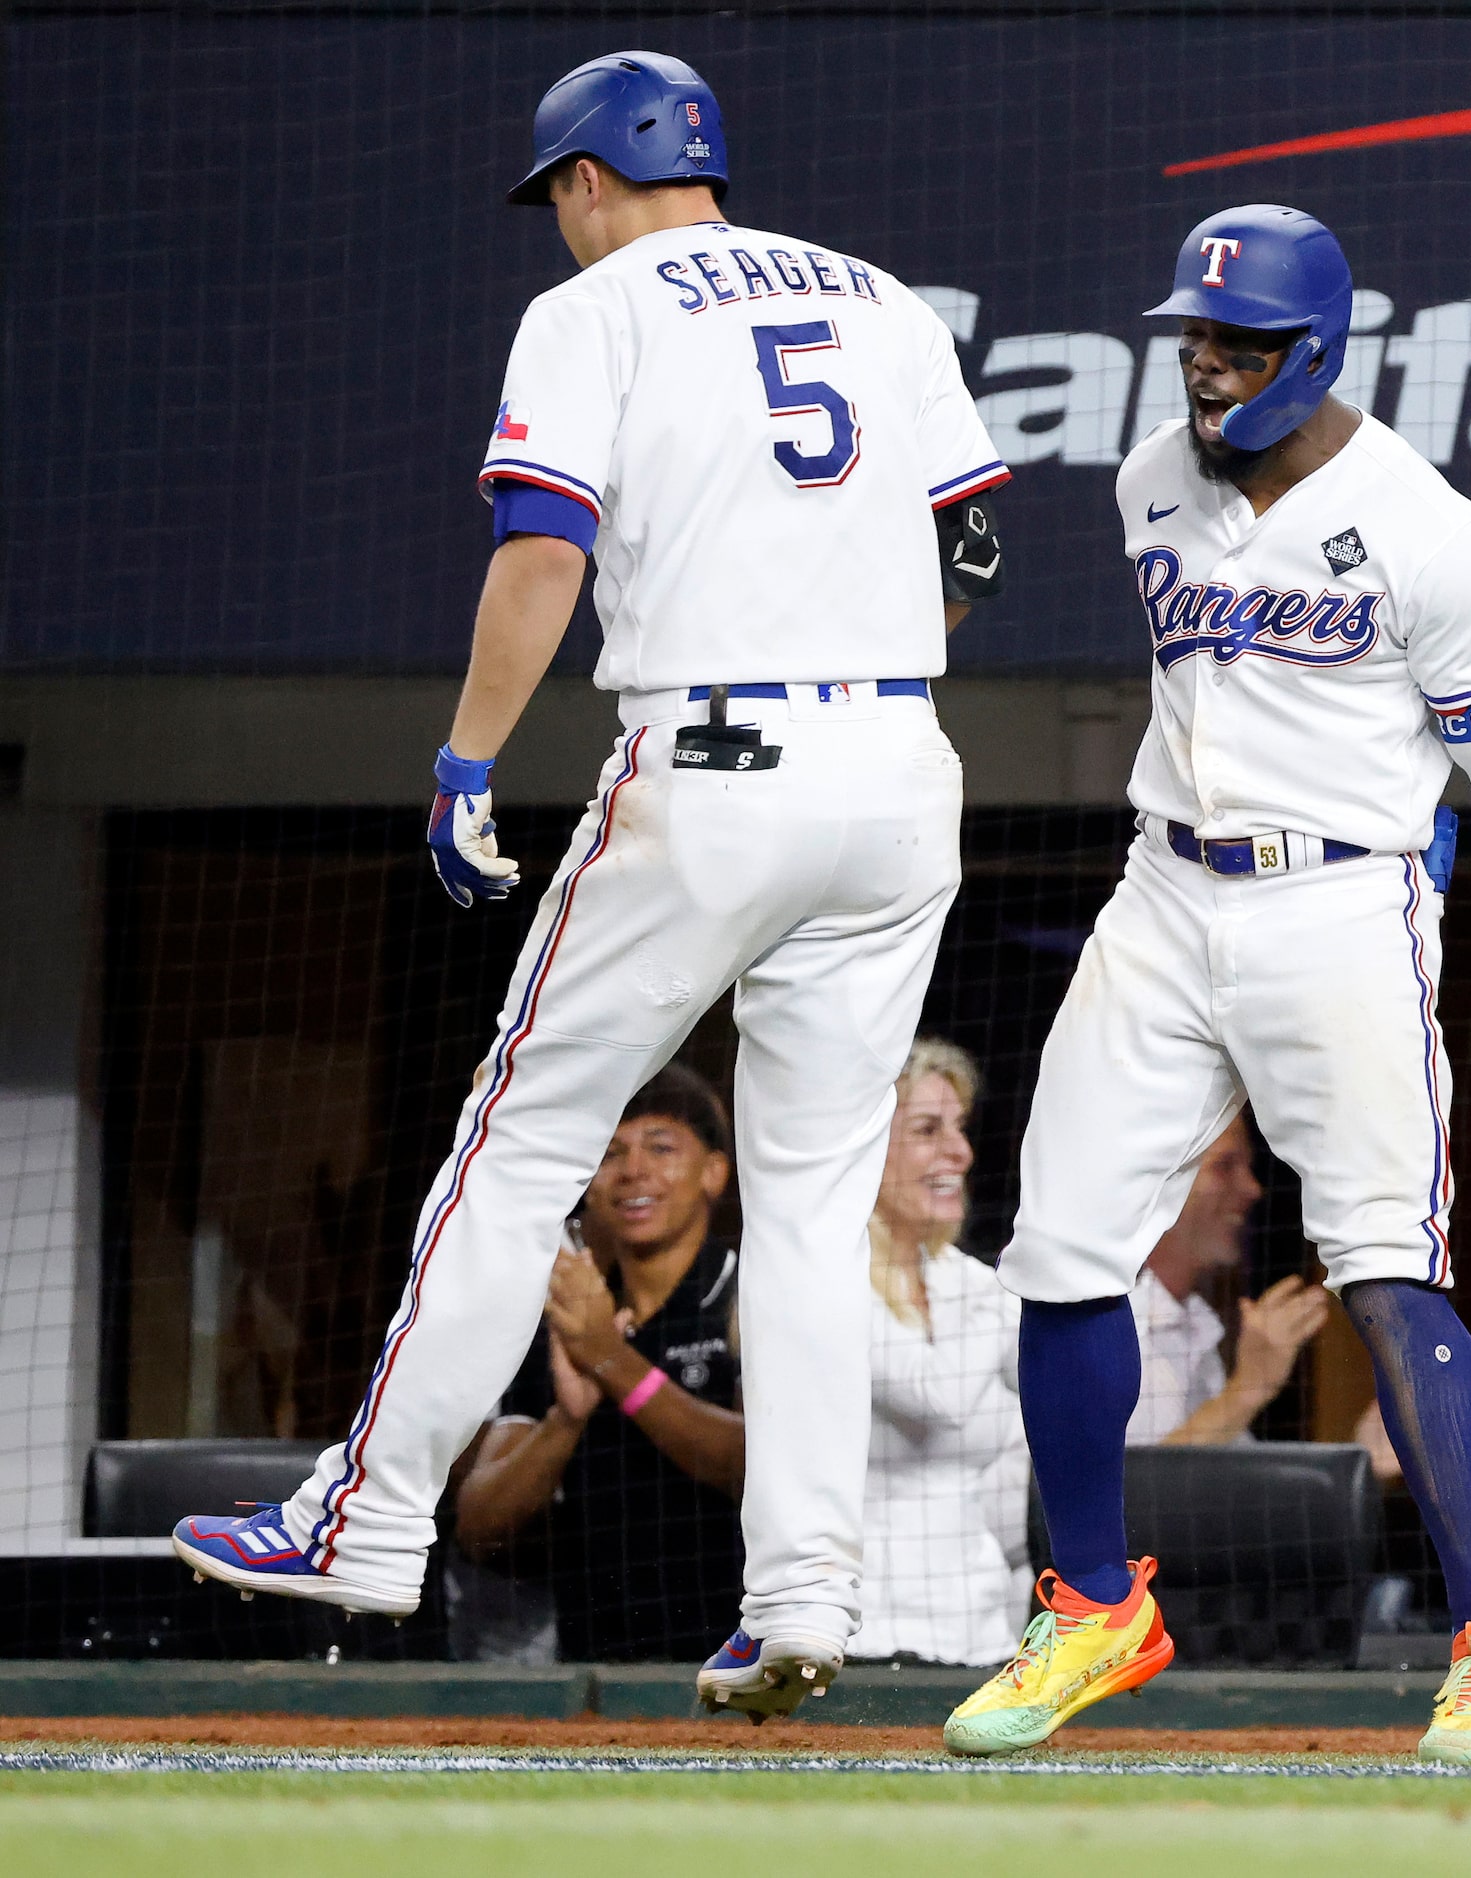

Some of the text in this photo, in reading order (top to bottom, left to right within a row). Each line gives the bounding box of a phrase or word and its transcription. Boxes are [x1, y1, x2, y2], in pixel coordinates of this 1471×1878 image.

[686, 103, 701, 126] 5
[1200, 237, 1243, 288] T
[657, 249, 882, 314] SEAGER
[751, 320, 862, 488] 5
[1325, 547, 1361, 566] SERIES
[1329, 539, 1364, 557] WORLD
[1135, 546, 1386, 670] Rangers
[1260, 846, 1278, 868] 53
